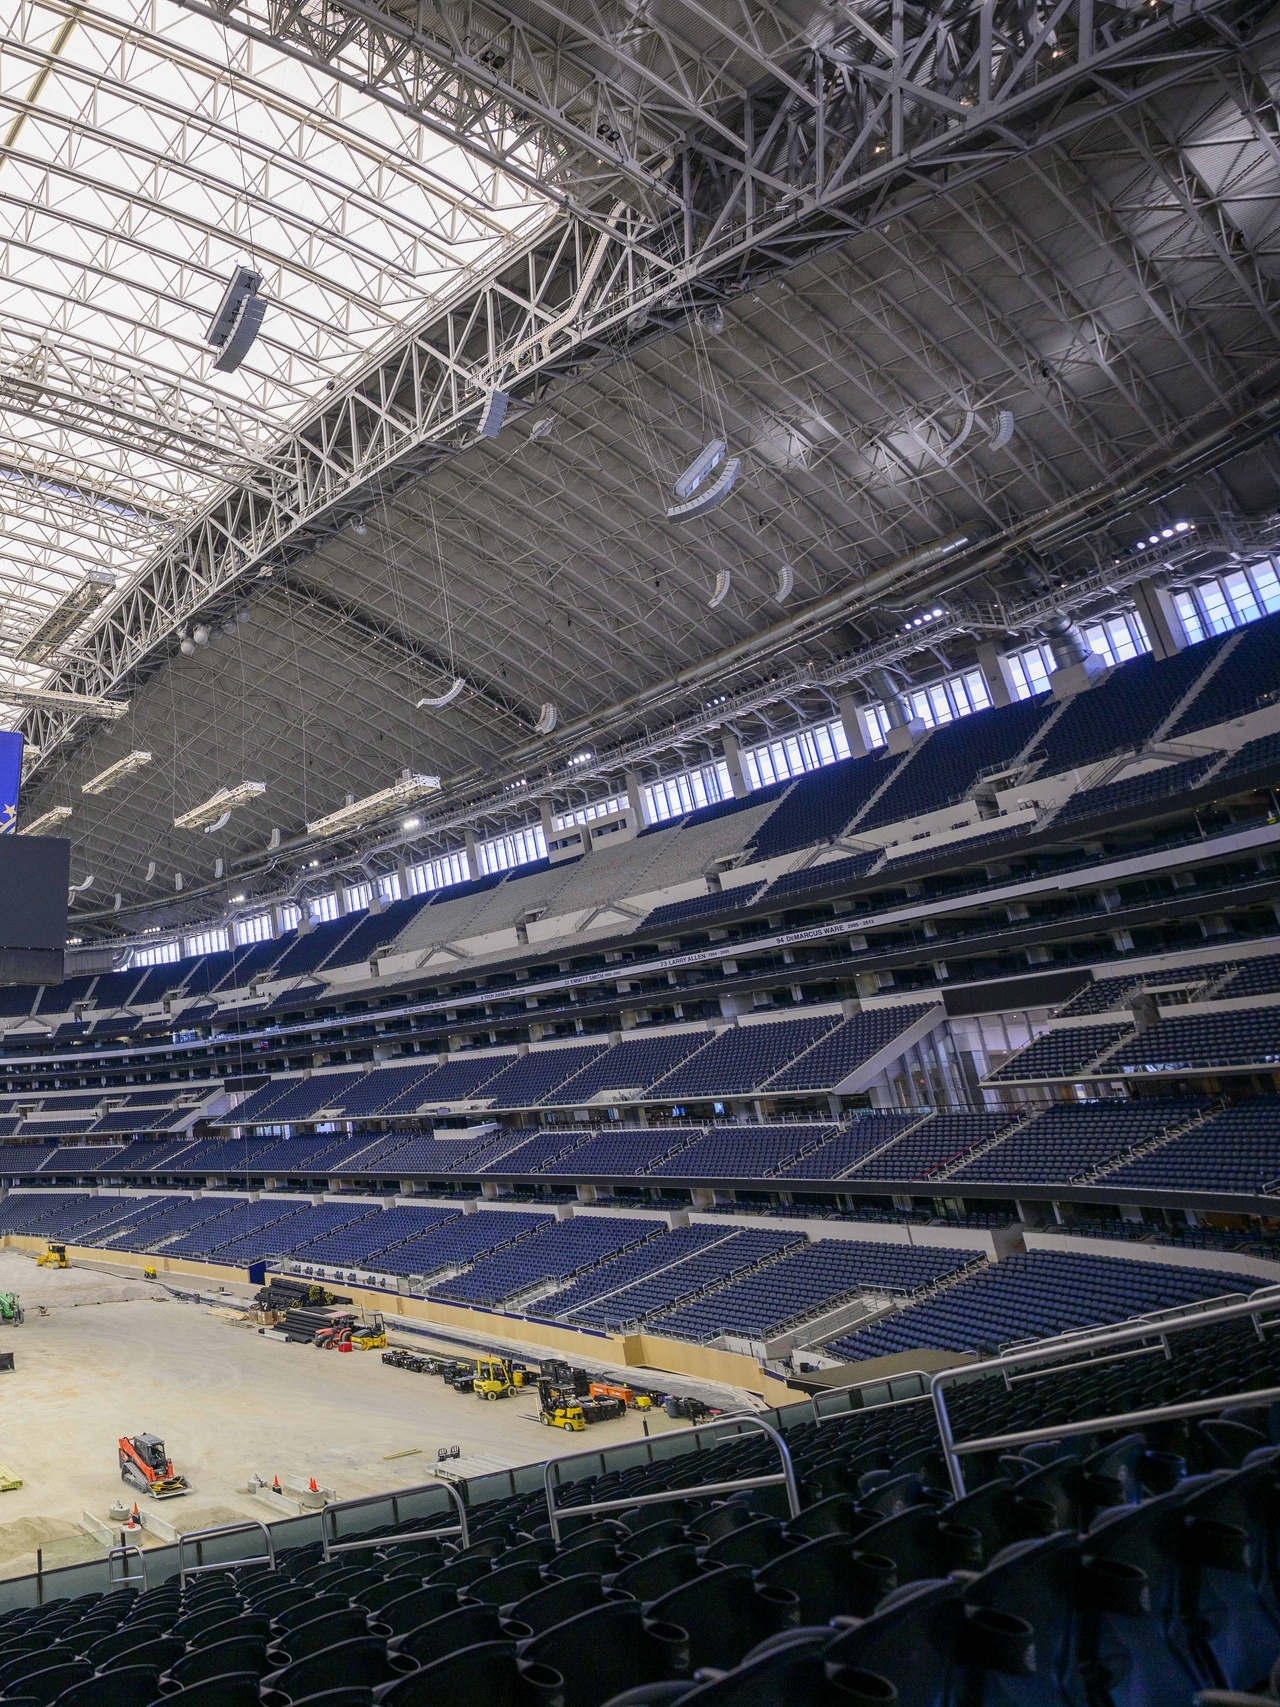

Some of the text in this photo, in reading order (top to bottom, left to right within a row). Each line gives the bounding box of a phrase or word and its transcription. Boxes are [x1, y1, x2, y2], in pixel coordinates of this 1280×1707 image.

[823, 925, 845, 935] WARE
[668, 957, 687, 966] LARRY
[687, 953, 706, 961] ALLEN
